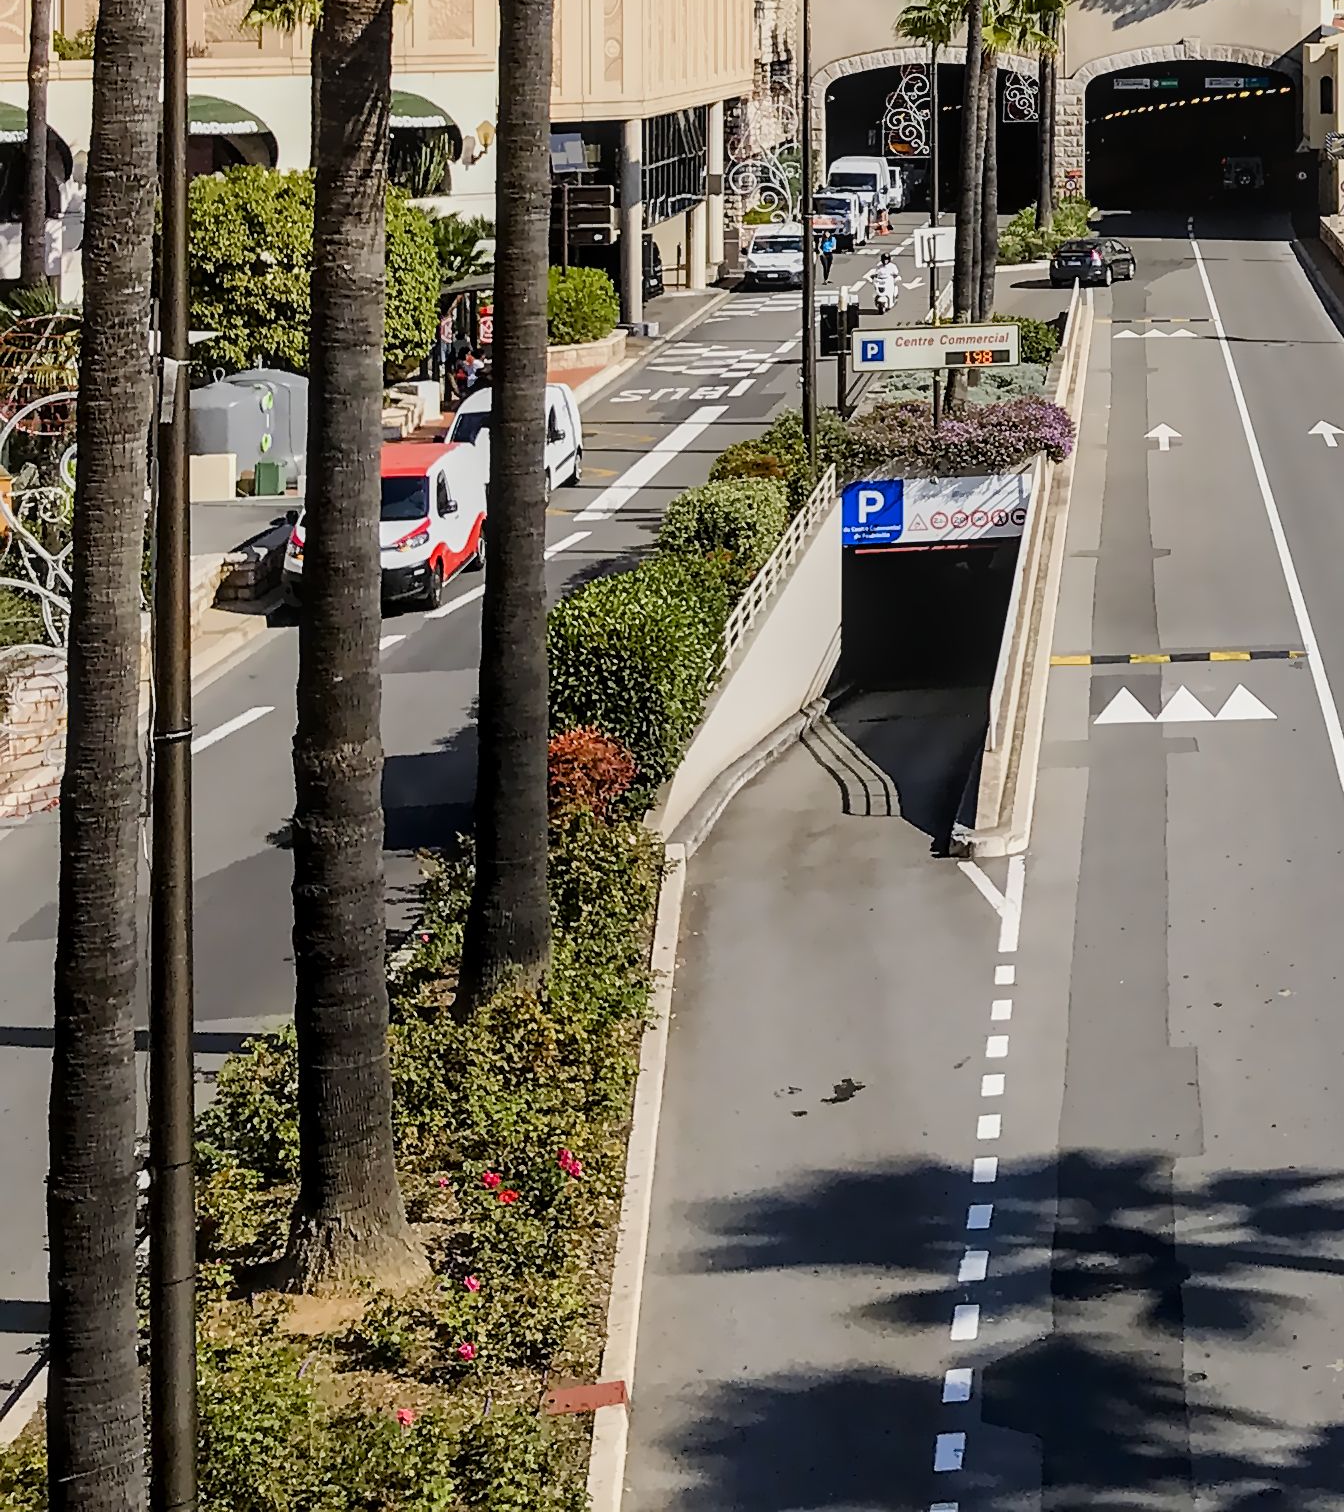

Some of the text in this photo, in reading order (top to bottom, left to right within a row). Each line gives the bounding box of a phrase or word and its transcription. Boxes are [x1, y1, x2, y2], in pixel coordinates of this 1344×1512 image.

[895, 332, 1009, 347] Centre Commercial
[867, 343, 879, 359] P
[965, 350, 992, 364] 198
[609, 386, 730, 402] BUS
[859, 490, 885, 523] P
